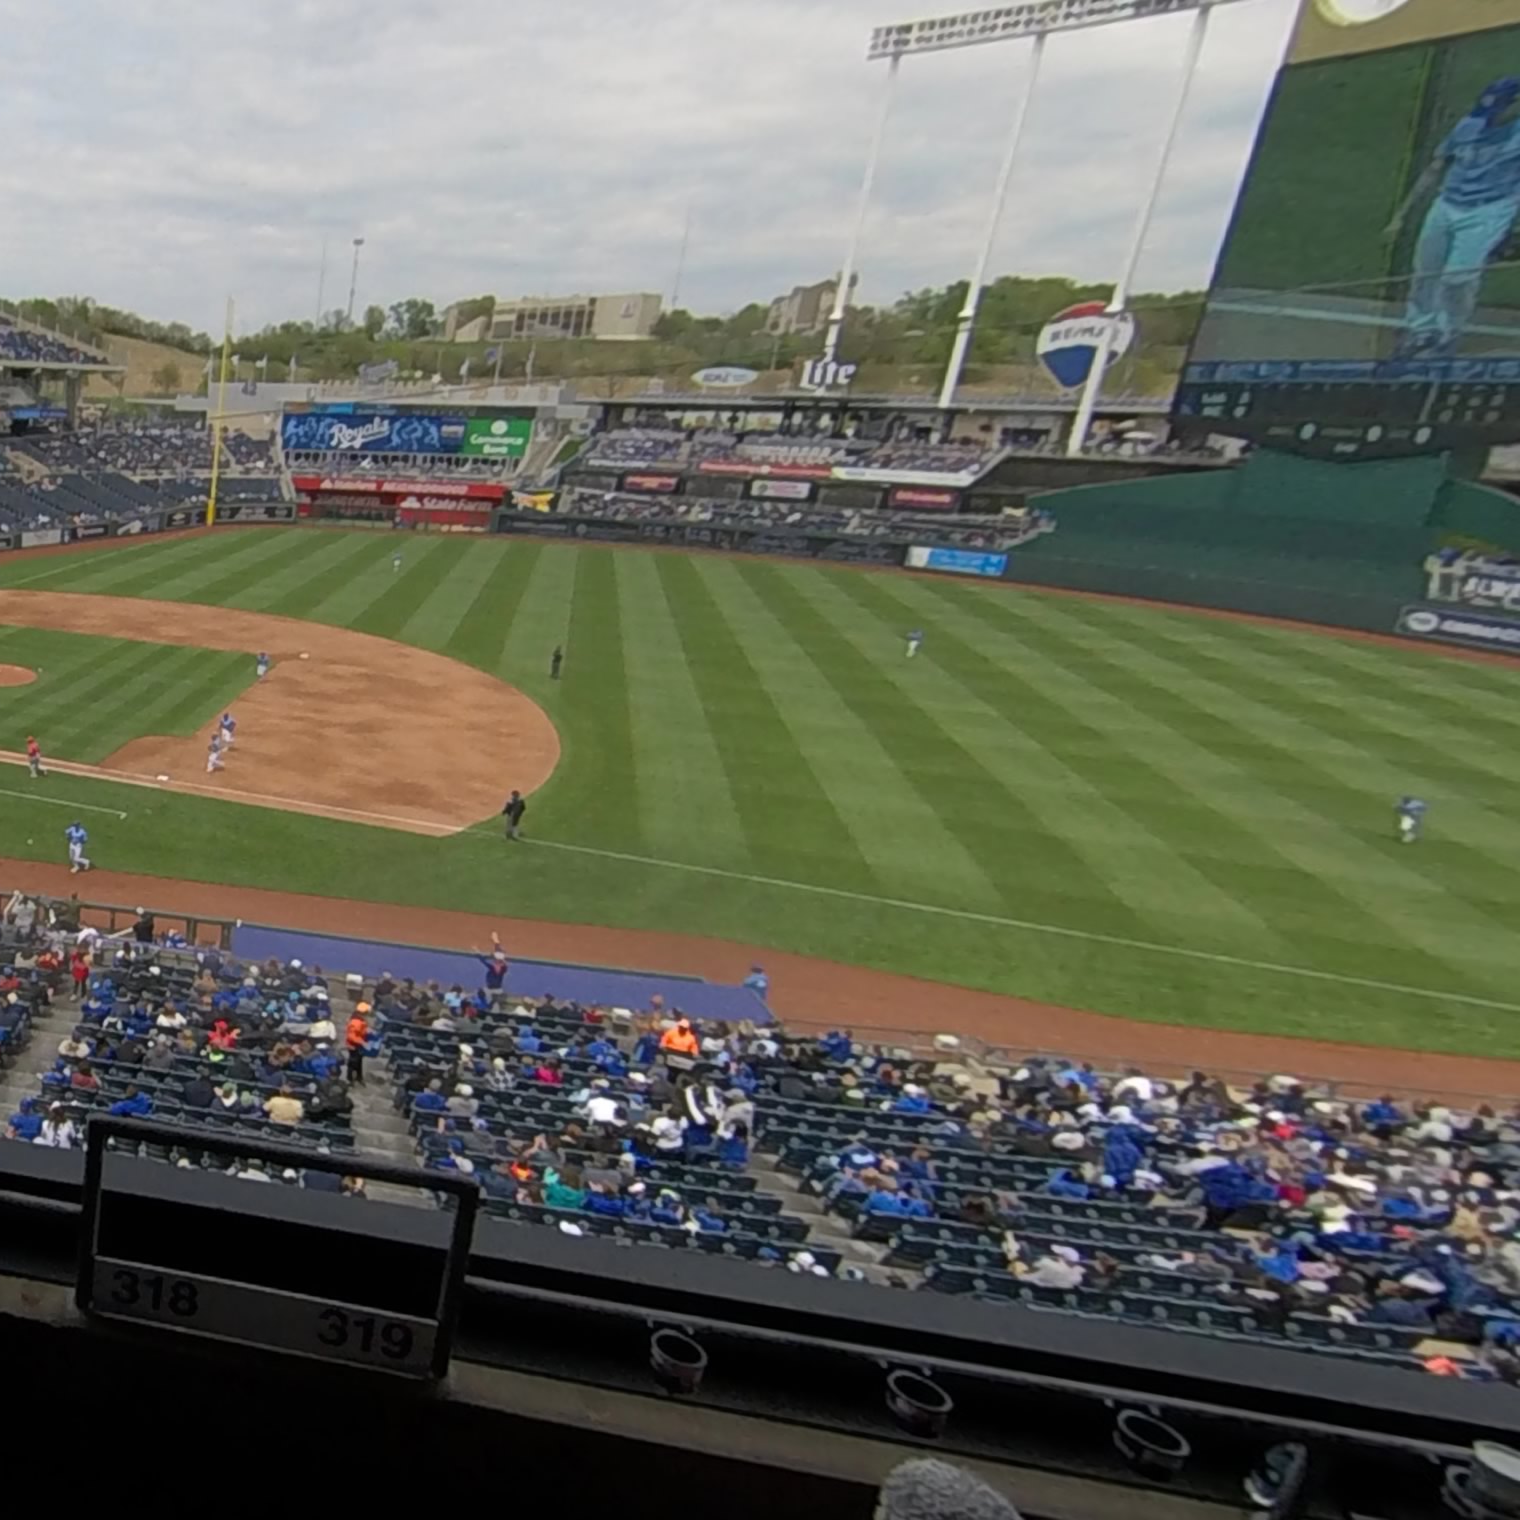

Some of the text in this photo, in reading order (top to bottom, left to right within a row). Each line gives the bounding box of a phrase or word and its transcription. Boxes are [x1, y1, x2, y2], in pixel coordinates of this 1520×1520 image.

[799, 359, 857, 390] Lite
[330, 416, 390, 449] Royals
[111, 1270, 199, 1318] 318
[317, 1309, 414, 1360] 319
